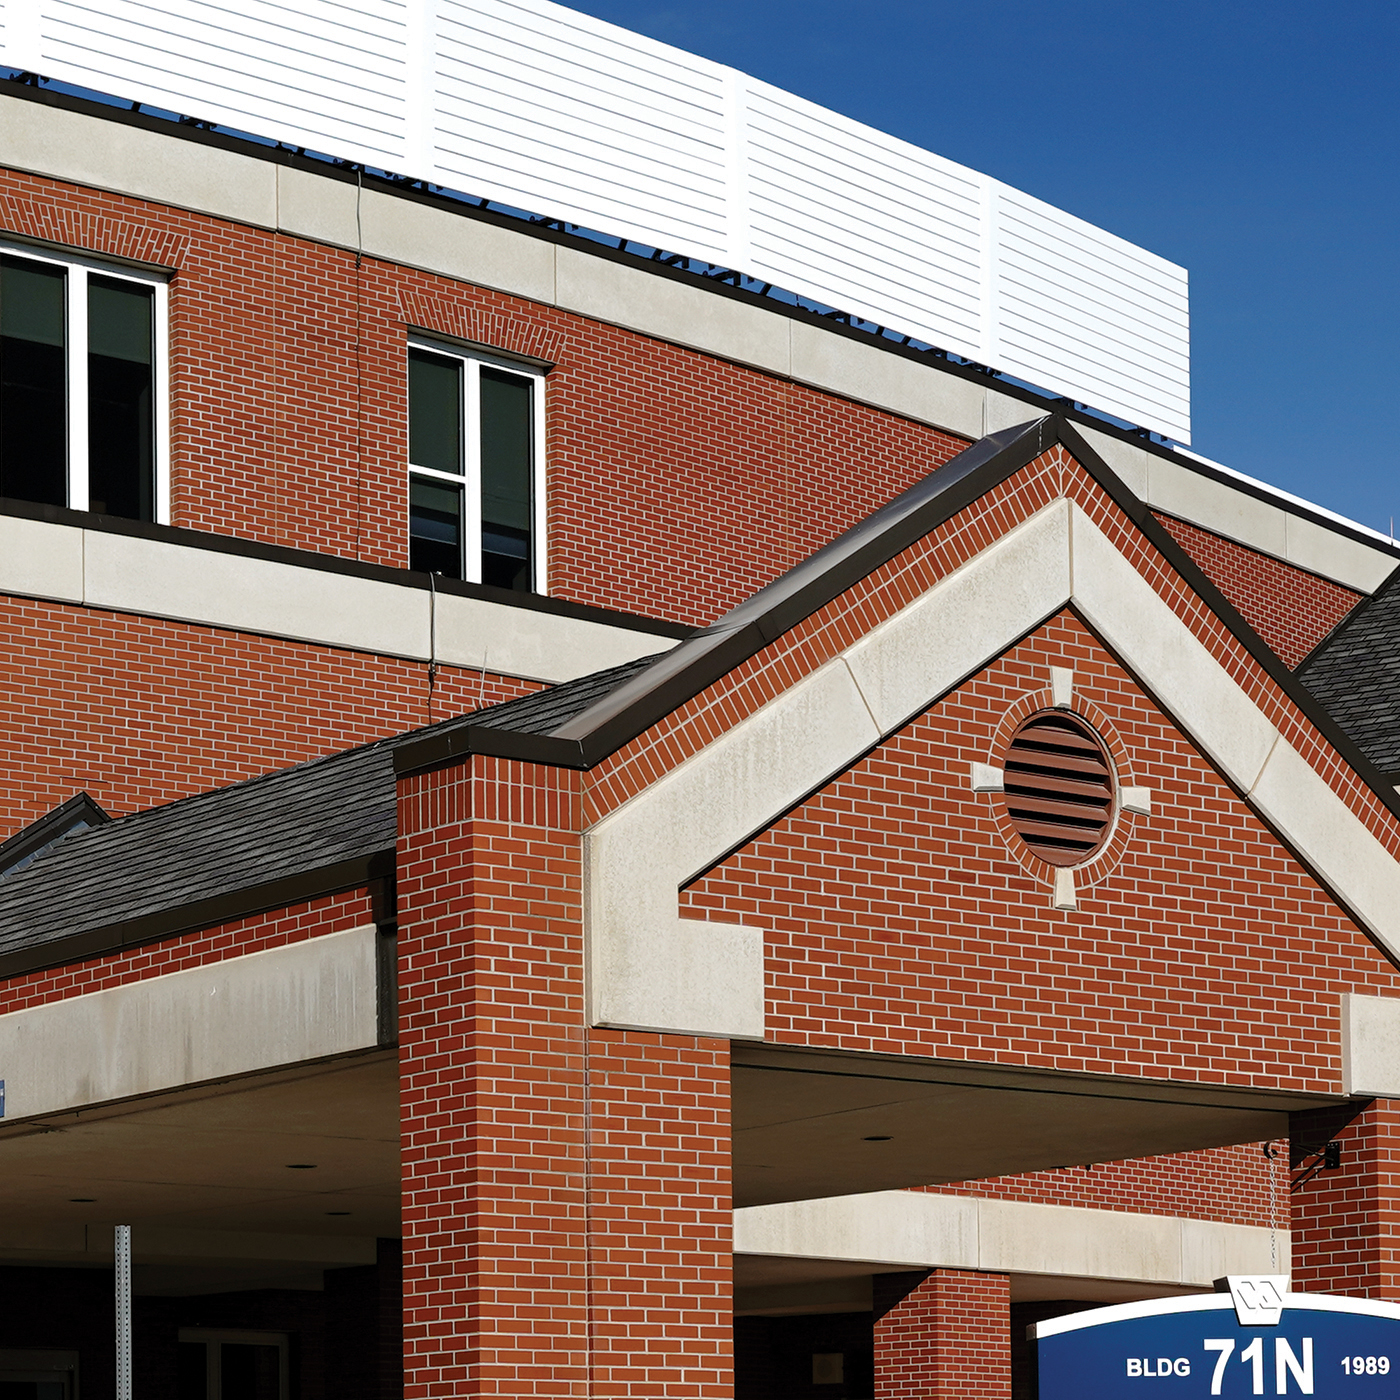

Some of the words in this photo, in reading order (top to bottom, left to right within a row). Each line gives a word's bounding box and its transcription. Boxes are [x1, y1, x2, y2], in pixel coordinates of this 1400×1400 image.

[1126, 1358, 1191, 1377] BLDG
[1203, 1336, 1315, 1396] 71N
[1340, 1356, 1391, 1375] 1989
